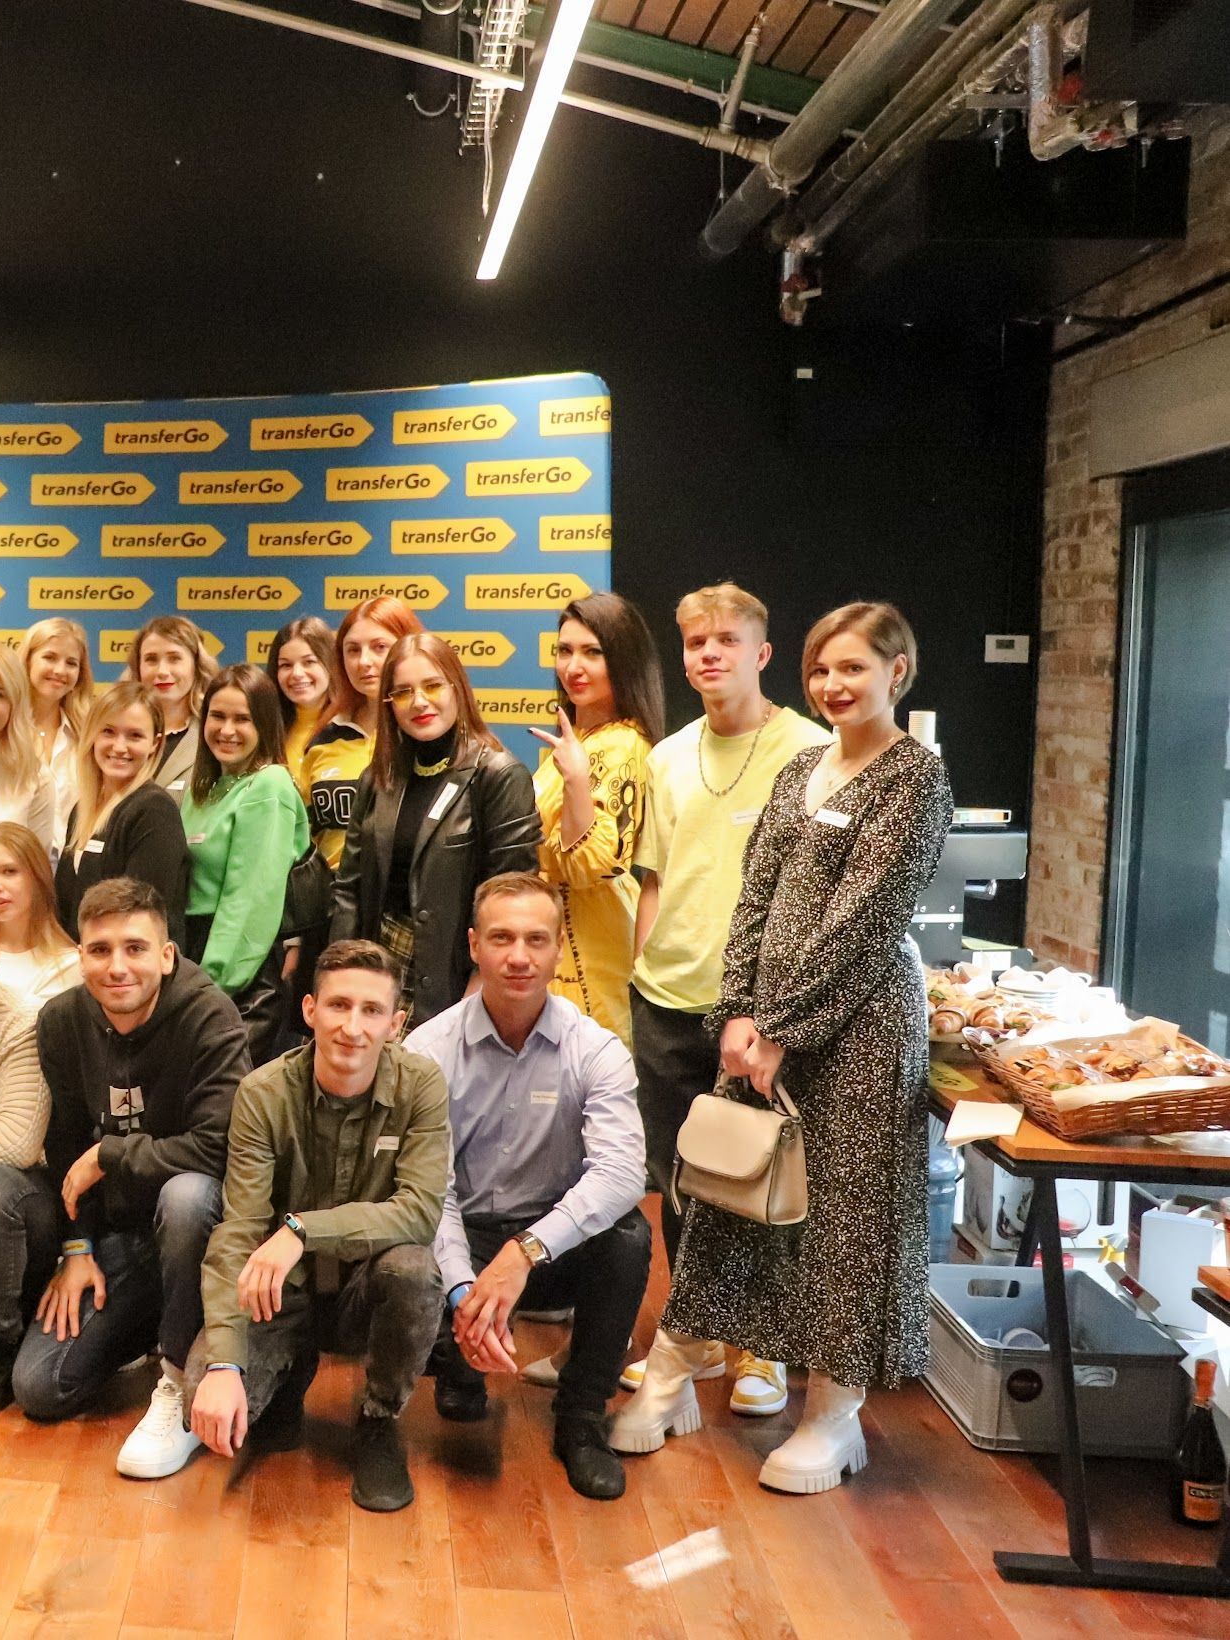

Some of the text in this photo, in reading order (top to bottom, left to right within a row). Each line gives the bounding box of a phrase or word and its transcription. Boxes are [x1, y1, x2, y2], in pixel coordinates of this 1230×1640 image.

[261, 422, 355, 441] transferGo
[403, 414, 498, 435] transferGo
[114, 427, 210, 444] transferGo
[336, 472, 431, 492] transferGo
[476, 467, 572, 486] transferGo
[41, 481, 137, 497] transferGo
[189, 477, 285, 495] transferGo
[112, 531, 207, 548] transferGo
[258, 530, 353, 547] transferGo
[401, 527, 497, 545] transferGo
[39, 585, 135, 601] transferGo
[187, 585, 283, 601] transferGo
[335, 584, 430, 600] transferGo
[475, 583, 572, 600] transferGo
